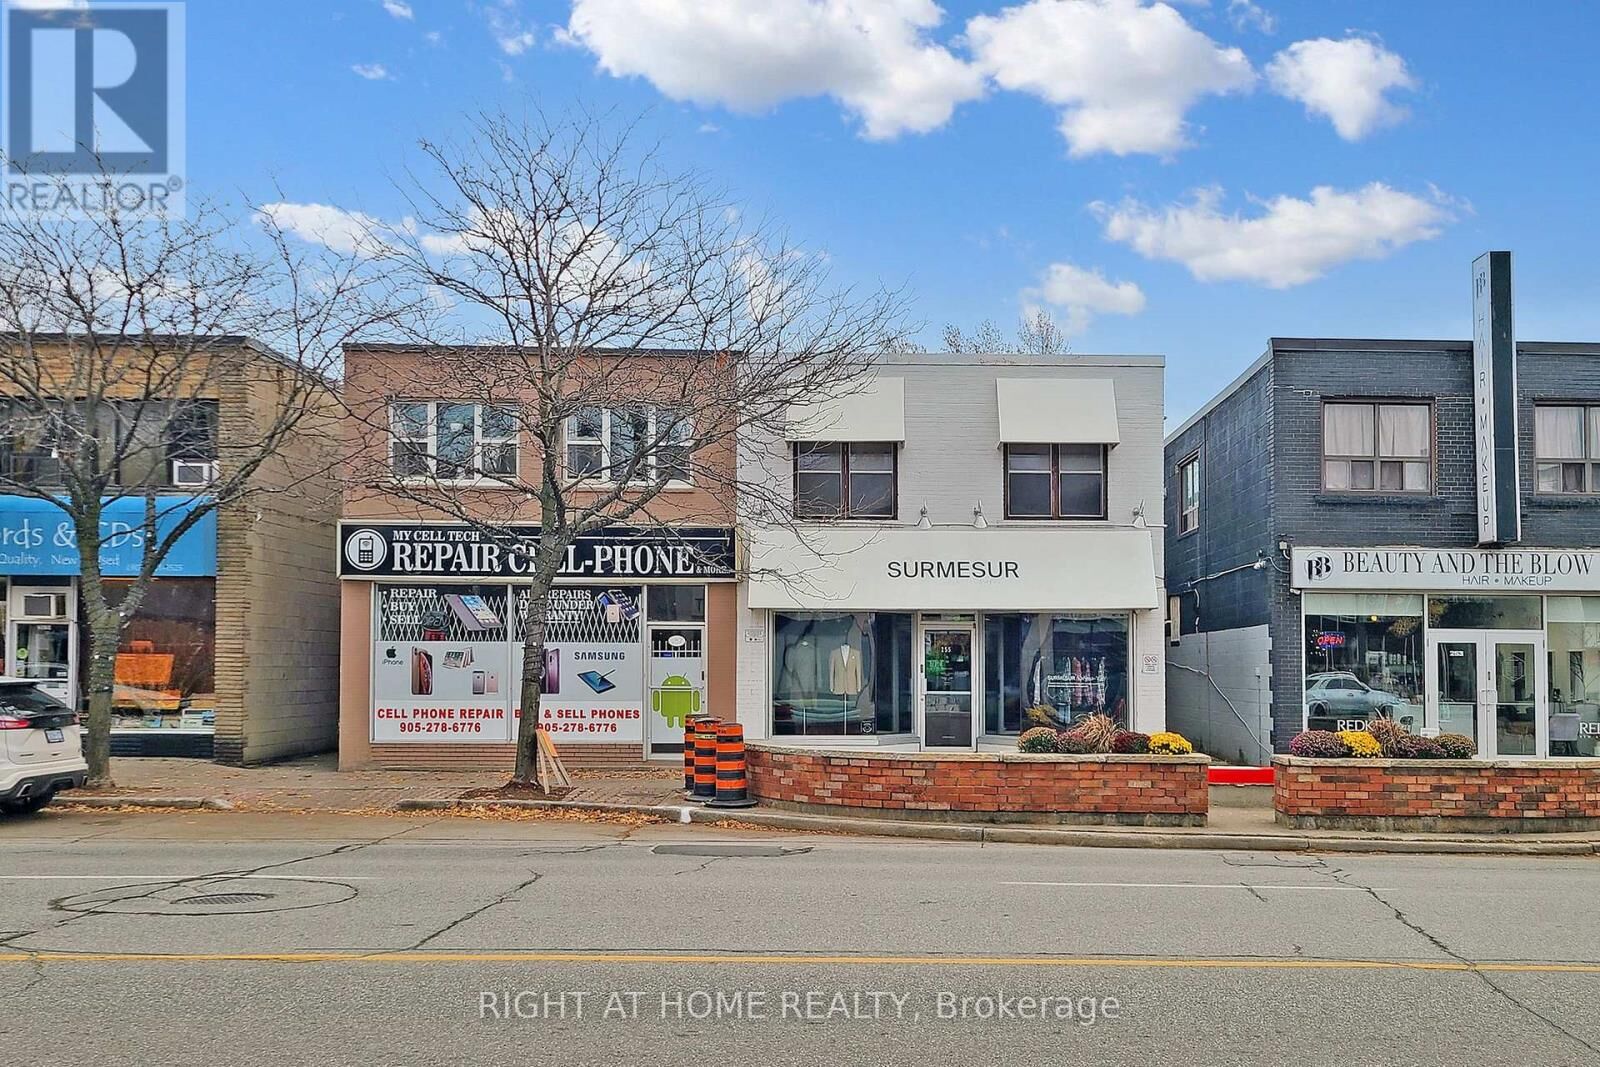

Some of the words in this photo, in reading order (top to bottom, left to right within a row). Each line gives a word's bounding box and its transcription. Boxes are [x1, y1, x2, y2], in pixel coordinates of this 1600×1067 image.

[0, 519, 43, 549] rds
[53, 522, 76, 548] &
[393, 530, 411, 541] MY
[413, 530, 446, 542] CELL
[447, 531, 480, 542] TECH
[99, 553, 120, 566] sed
[391, 542, 502, 573] REPAIR
[1343, 551, 1427, 574] BEAUTY
[1431, 552, 1475, 574] AND
[1480, 552, 1523, 574] THE
[1531, 553, 1593, 575] BLOW
[887, 561, 1019, 578] SURMESUR
[1462, 575, 1490, 585] HAIR
[1503, 576, 1553, 586] MAKEUP
[390, 588, 438, 599] REPAIR
[547, 589, 592, 600] EPAIRS
[390, 601, 417, 611] BUY
[554, 600, 594, 610] UNDER
[390, 615, 422, 625] SELL
[1317, 635, 1344, 645] OPEN
[574, 651, 625, 660] SAMSUNG
[377, 708, 408, 719] CELL
[412, 709, 454, 719] PHONE
[459, 709, 504, 719] REPAIR
[543, 710, 552, 719] &
[556, 710, 587, 719] SELL
[591, 710, 640, 719] PHONES
[399, 722, 481, 733] 905-278-6776
[1337, 719, 1375, 731] REDK
[1579, 722, 1600, 735] RE
